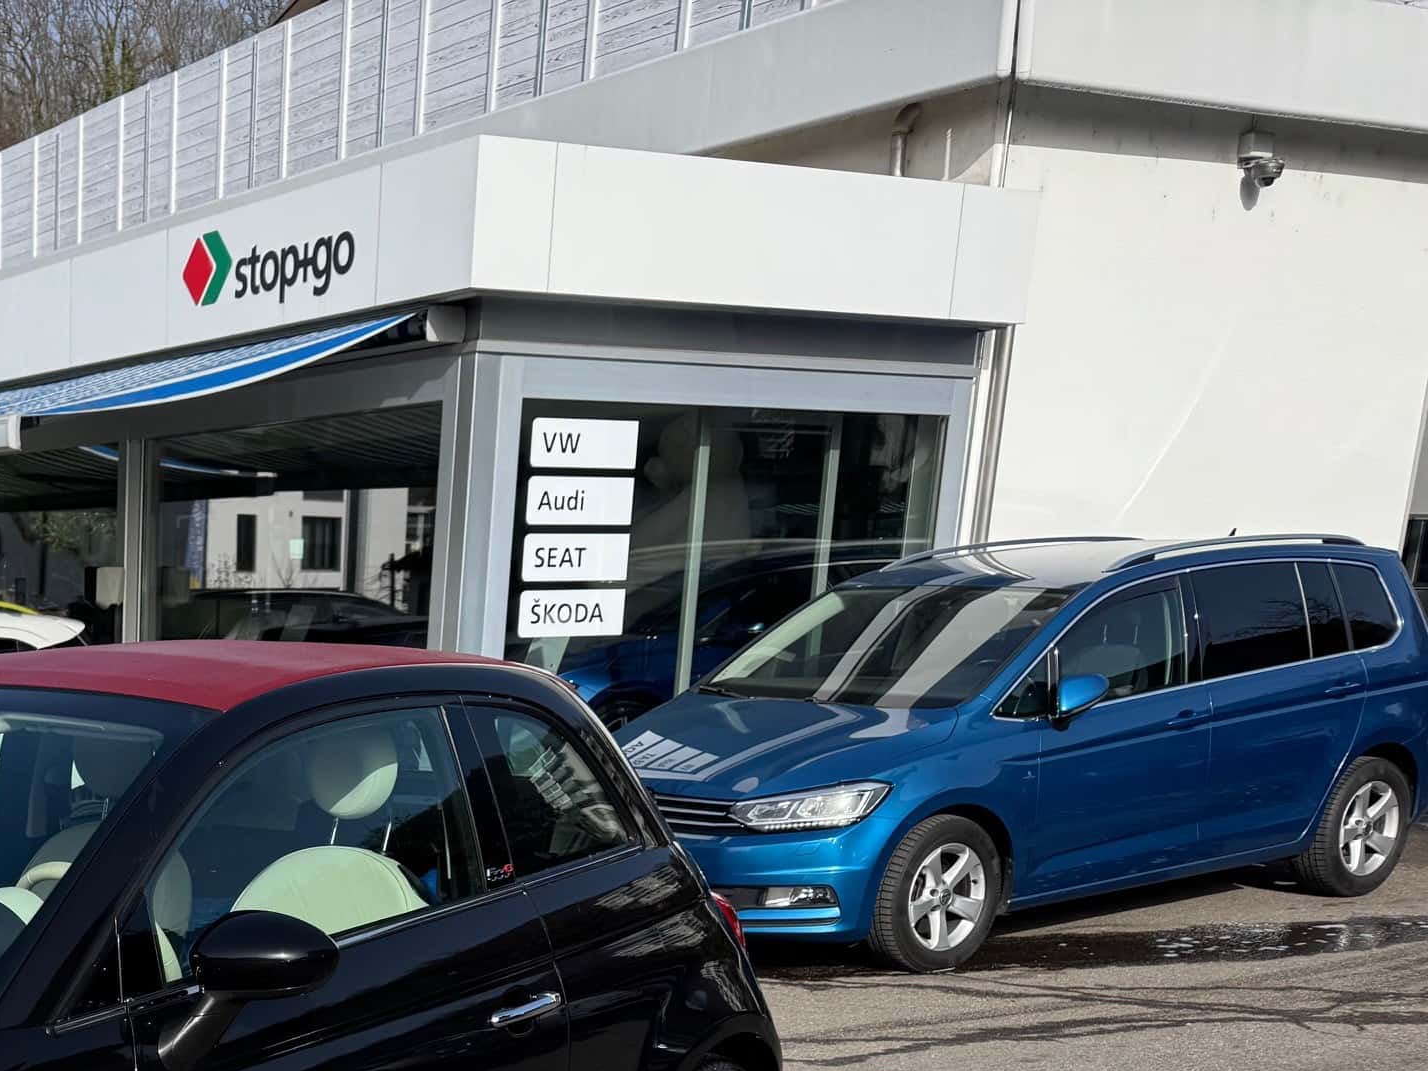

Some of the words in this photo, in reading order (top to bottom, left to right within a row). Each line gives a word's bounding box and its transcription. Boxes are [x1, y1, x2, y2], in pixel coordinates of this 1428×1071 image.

[234, 230, 355, 304] stop+go
[543, 431, 580, 454] VW
[538, 489, 585, 511] Audi
[534, 547, 587, 568] SEAT
[530, 598, 604, 625] ŠKODA
